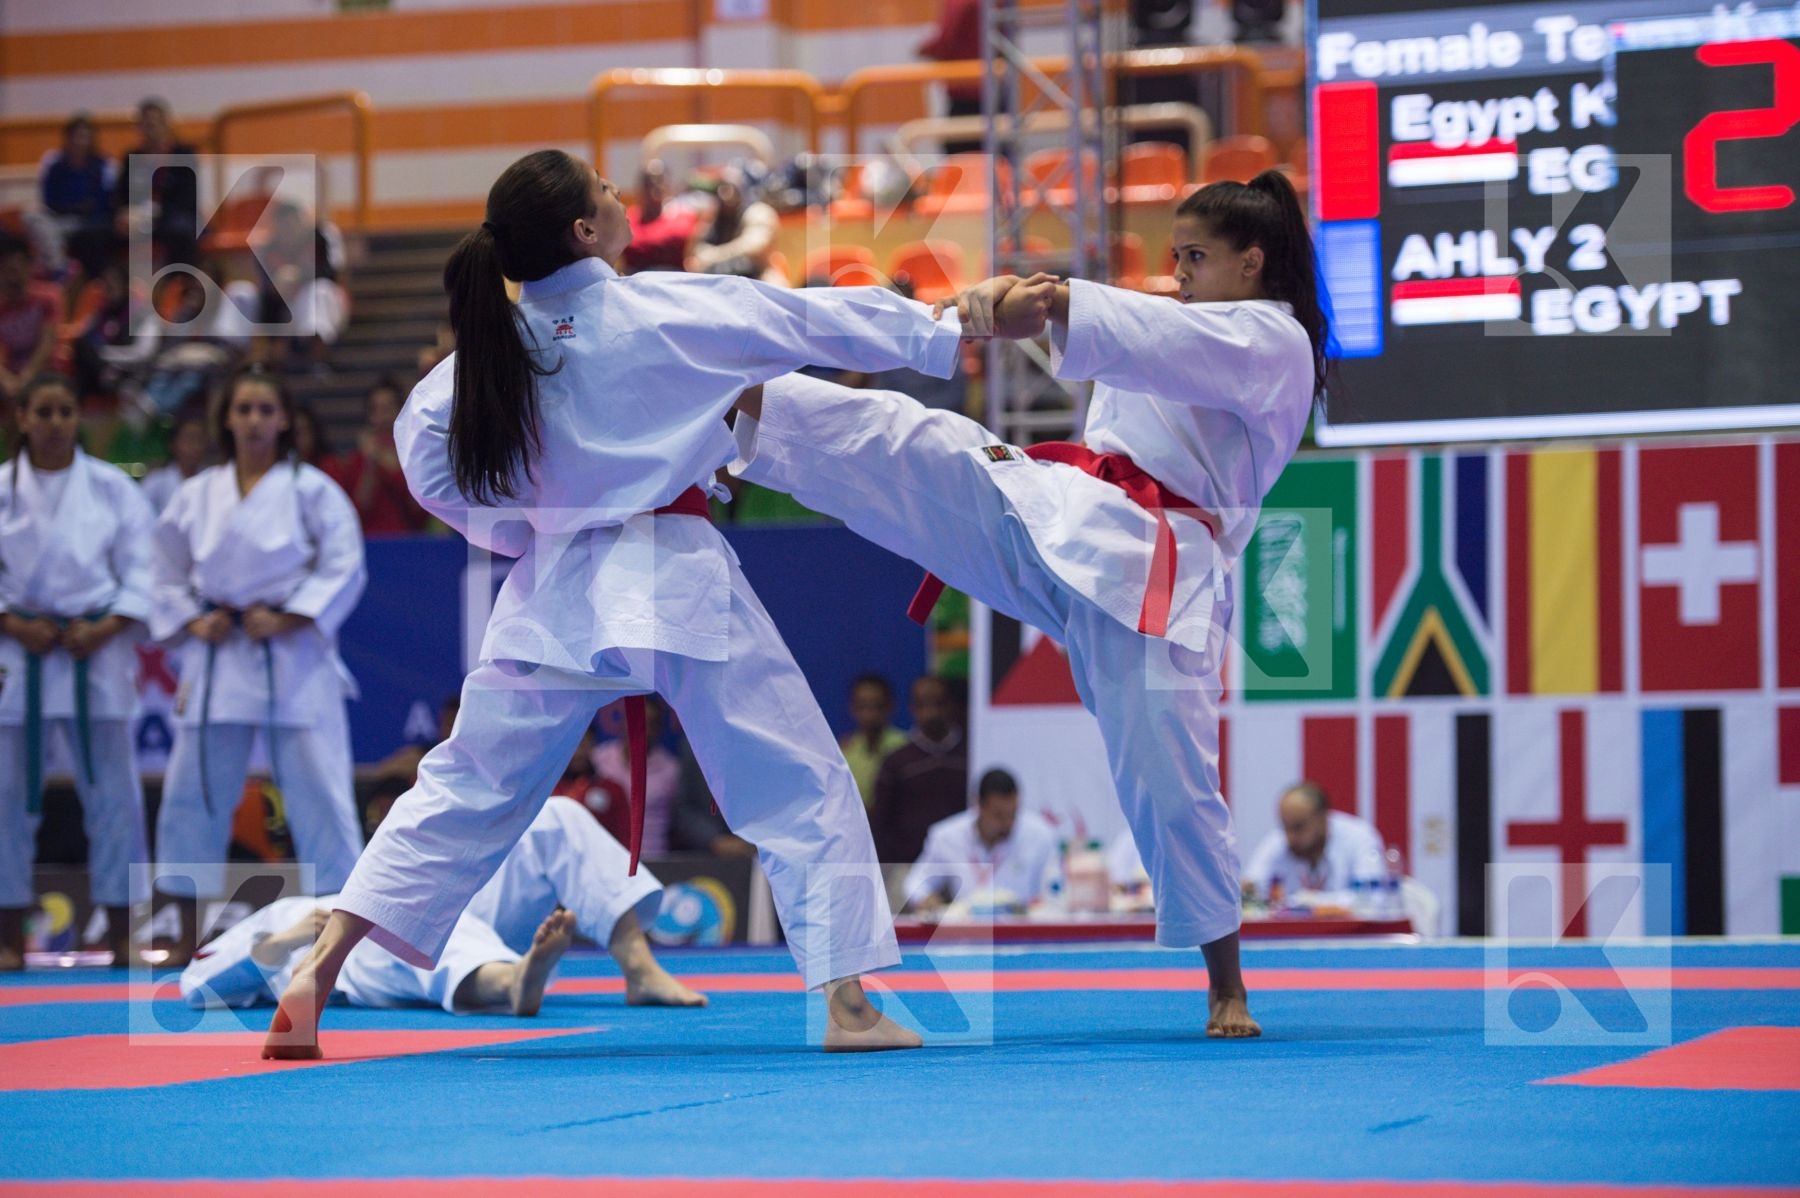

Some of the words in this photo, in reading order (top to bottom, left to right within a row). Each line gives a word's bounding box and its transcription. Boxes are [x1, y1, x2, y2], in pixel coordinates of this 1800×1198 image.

[1317, 21, 1523, 80] Female
[1390, 86, 1560, 148] Egypt
[1683, 37, 1800, 214] 2
[1391, 225, 1558, 282] AHLY
[1567, 223, 1608, 272] 2
[1530, 278, 1743, 337] EGYPT
